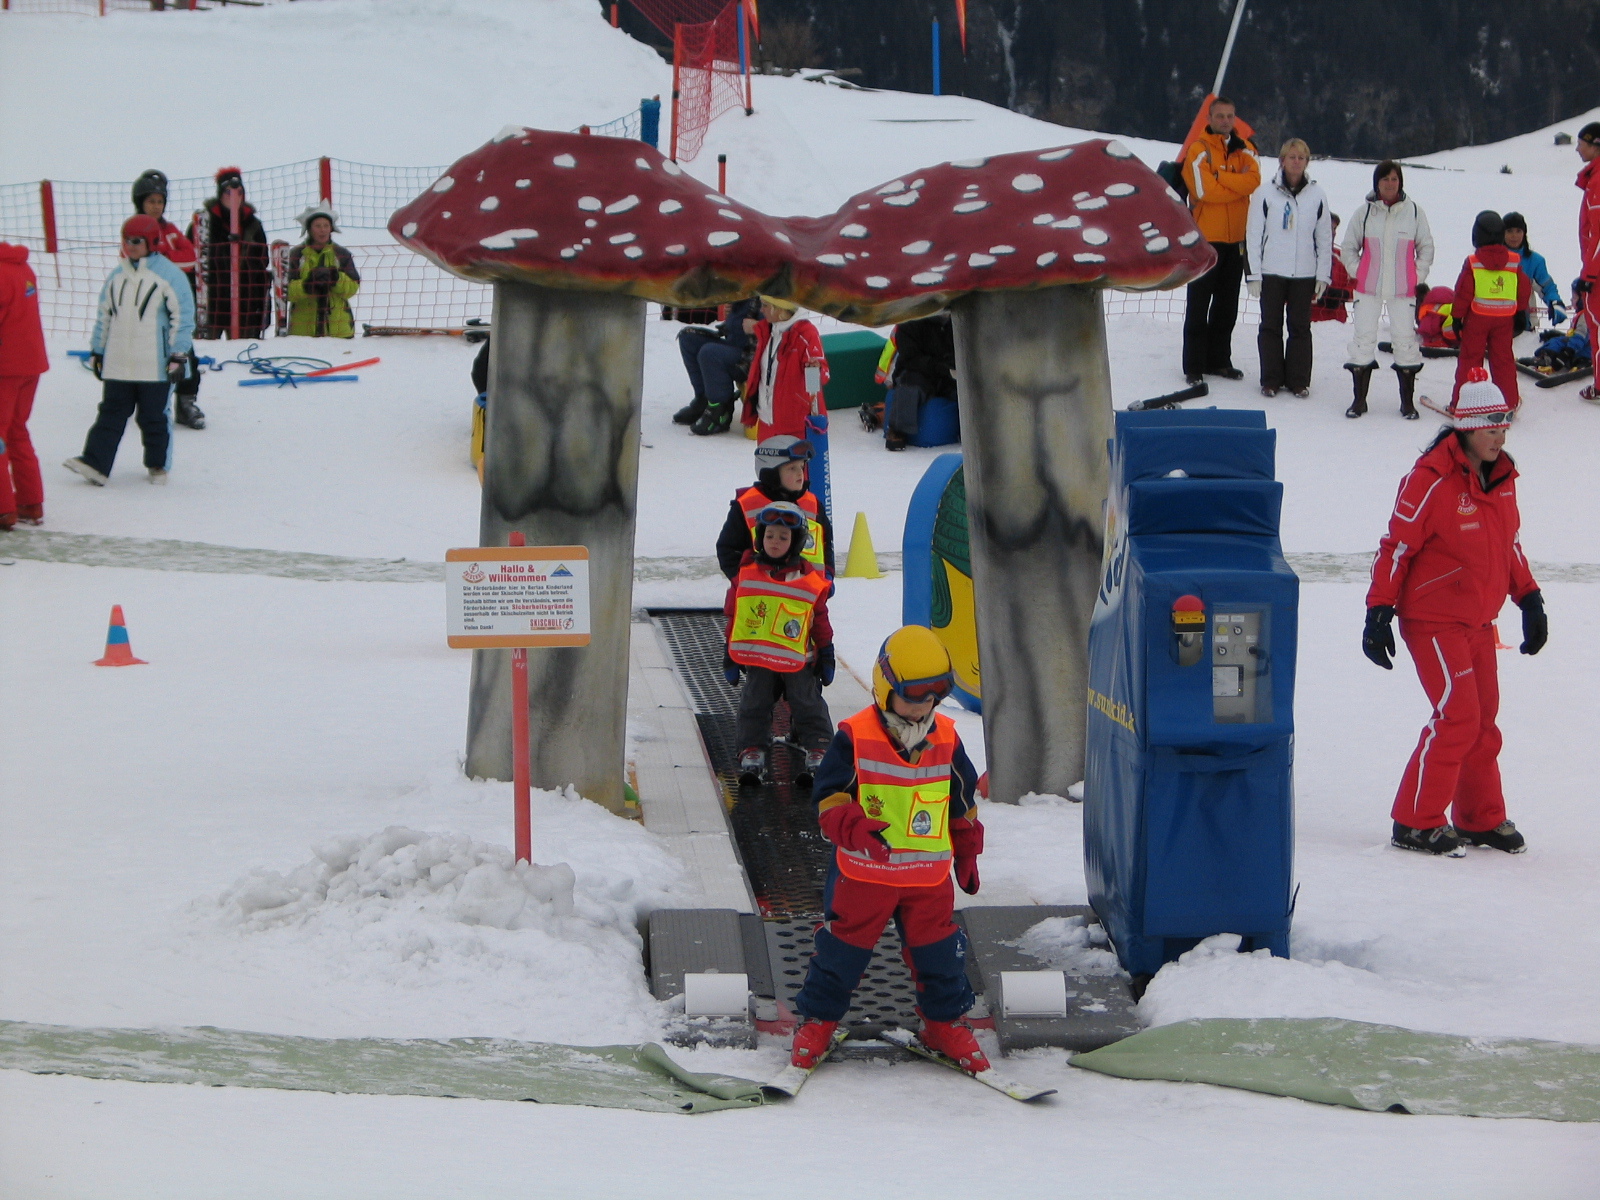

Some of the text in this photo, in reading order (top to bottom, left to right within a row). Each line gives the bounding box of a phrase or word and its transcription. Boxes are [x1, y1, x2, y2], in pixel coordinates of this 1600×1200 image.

[758, 448, 780, 456] uvex
[500, 564, 535, 574] Hallo &
[488, 573, 547, 583] Willkommen
[511, 603, 574, 611] Sicherheitsgründen
[530, 618, 562, 627] SKISCHULE
